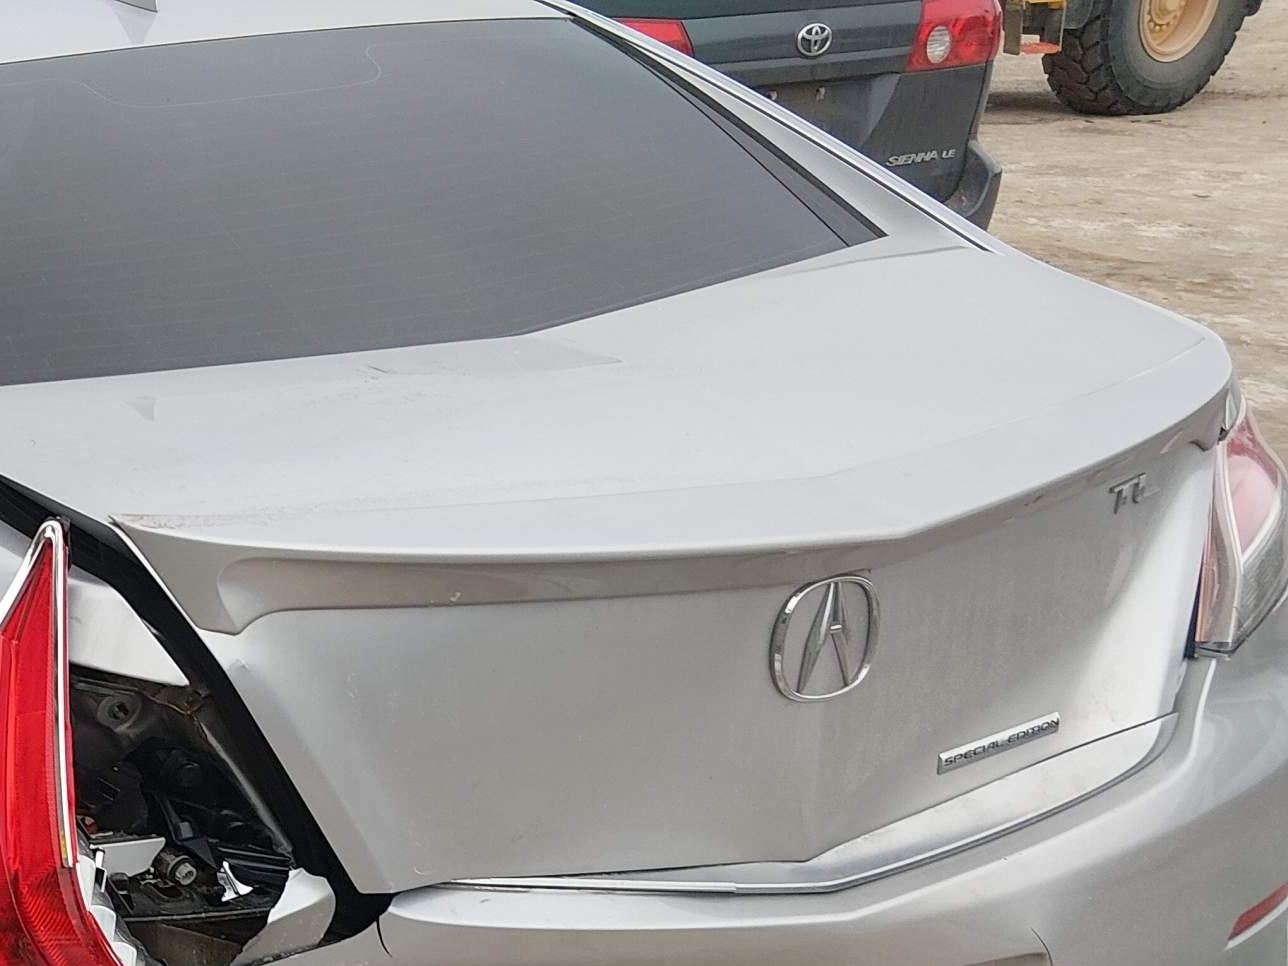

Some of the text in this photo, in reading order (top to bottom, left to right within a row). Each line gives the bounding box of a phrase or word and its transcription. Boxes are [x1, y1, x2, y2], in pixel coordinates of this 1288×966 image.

[886, 149, 956, 167] SIENNA LE
[1109, 472, 1160, 515] TL
[944, 718, 1060, 767] SPECIAL EDITION
